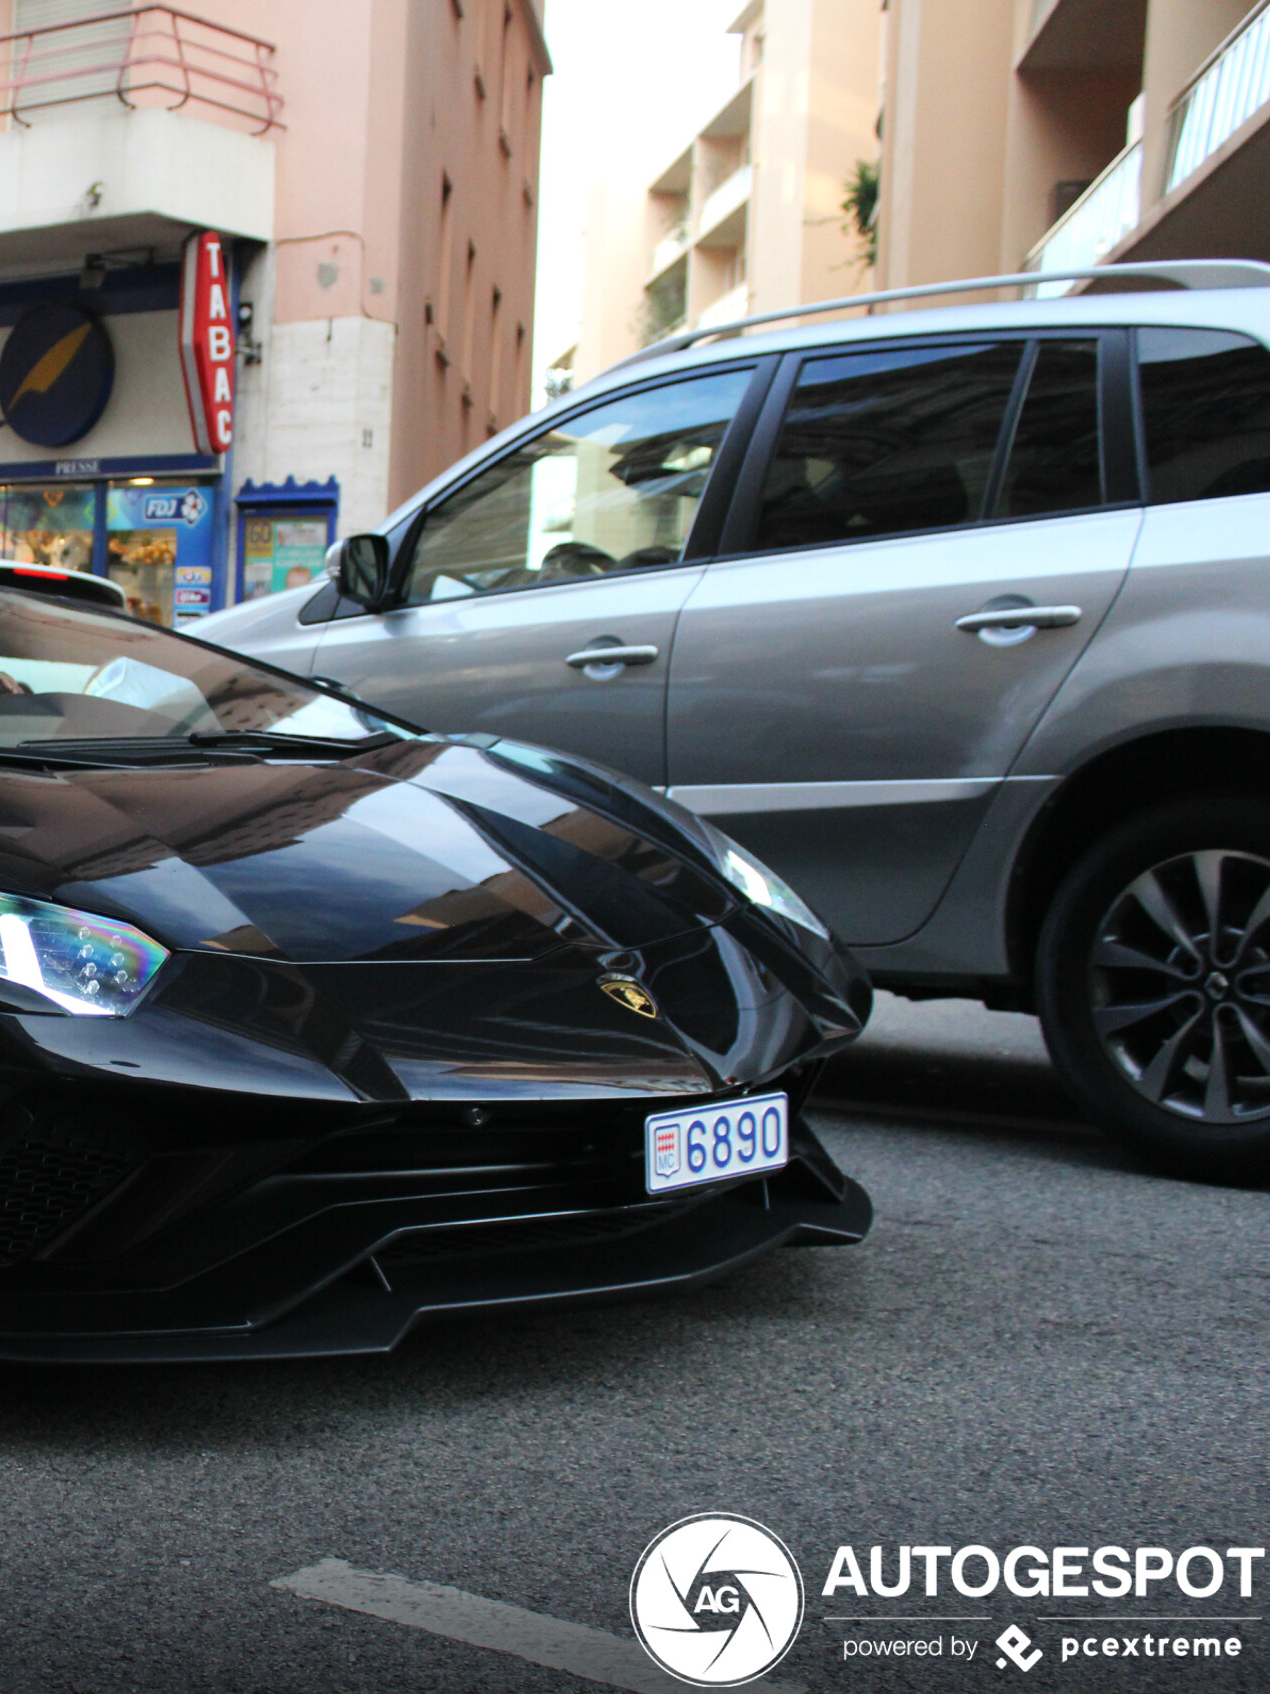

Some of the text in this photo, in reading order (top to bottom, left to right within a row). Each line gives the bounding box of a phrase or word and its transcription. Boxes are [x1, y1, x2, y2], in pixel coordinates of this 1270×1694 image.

[206, 241, 232, 447] TABAC
[55, 459, 102, 475] PRESSE
[147, 499, 178, 518] FDJ
[687, 1106, 782, 1173] 6890
[658, 1153, 675, 1170] MC
